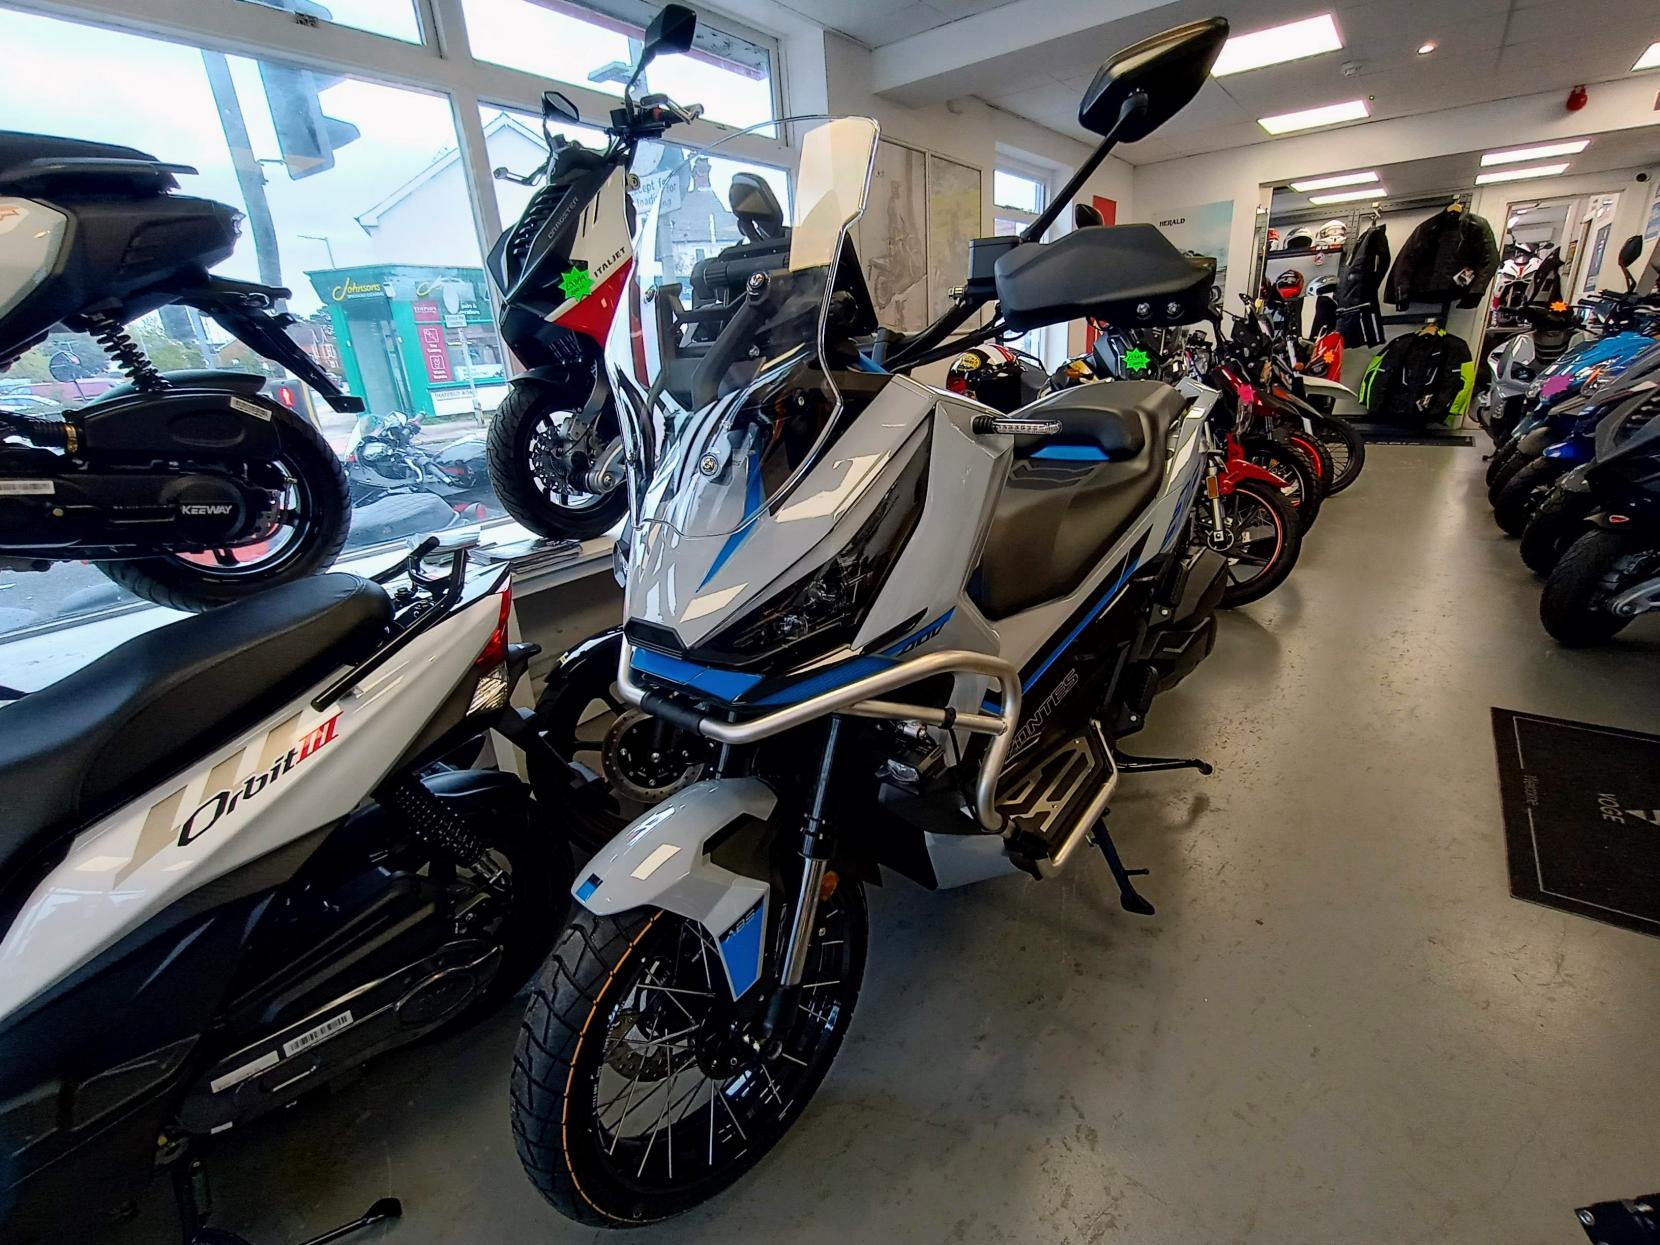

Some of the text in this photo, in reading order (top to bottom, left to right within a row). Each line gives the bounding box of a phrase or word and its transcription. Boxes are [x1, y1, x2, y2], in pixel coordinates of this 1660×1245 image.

[1159, 217, 1186, 227] HERALD
[593, 246, 627, 278] ITALJET
[332, 277, 381, 301] Johnsons
[181, 504, 233, 515] KEEWAY
[1598, 793, 1625, 824] VOGE
